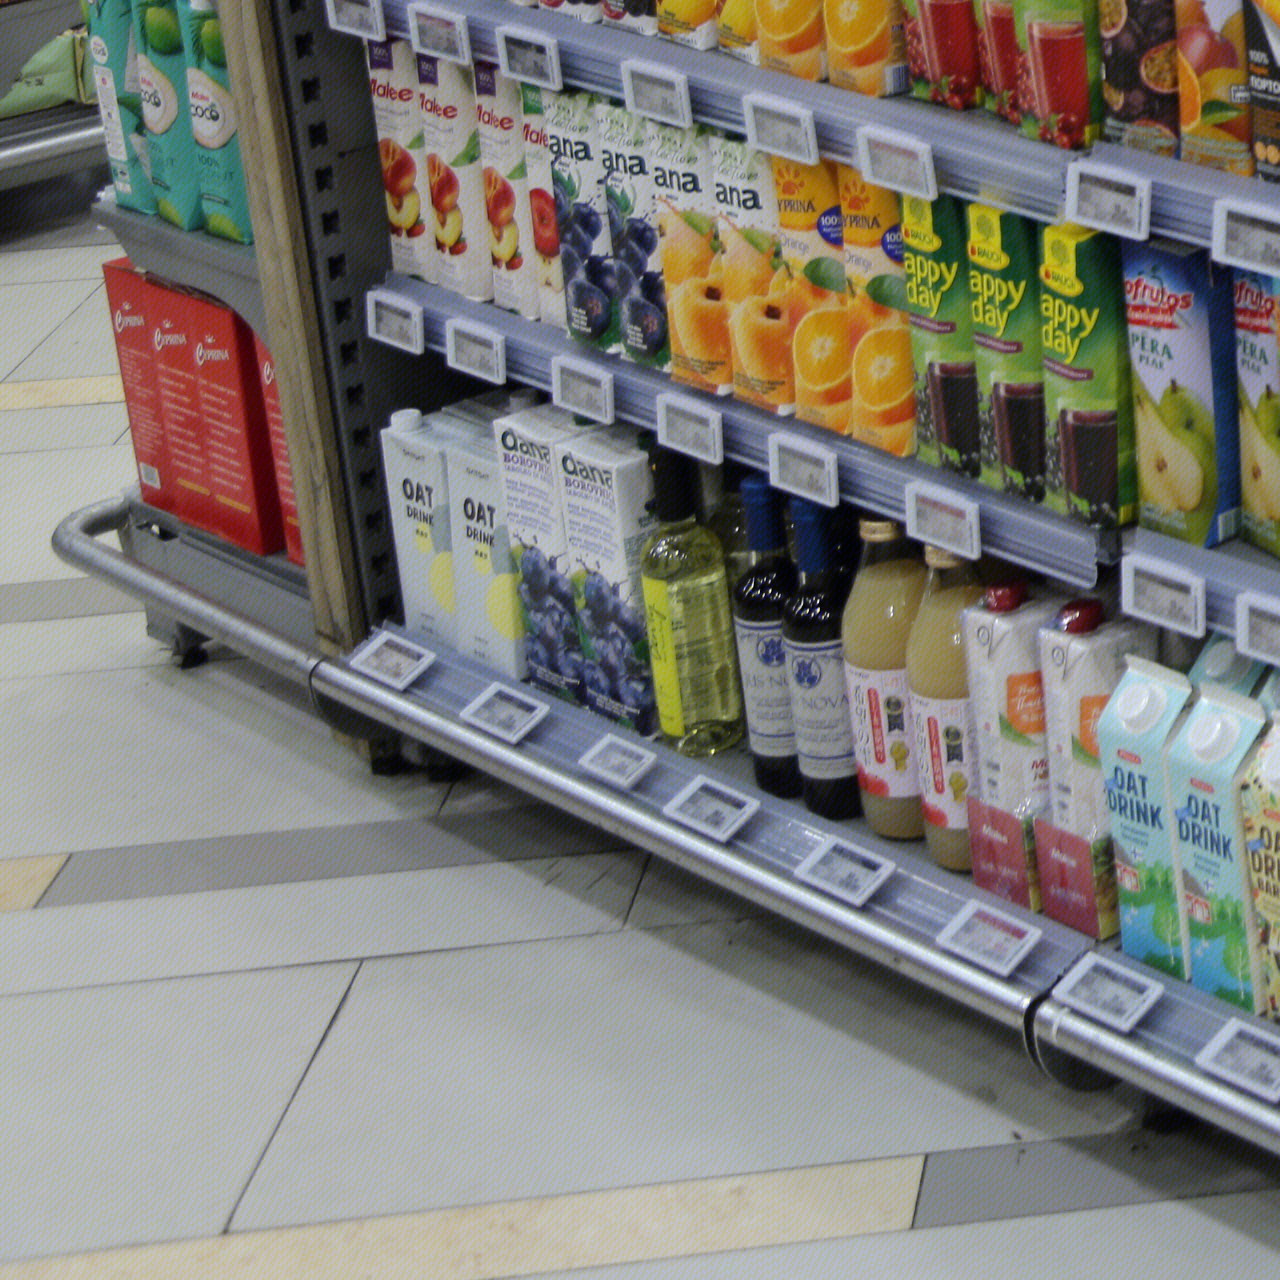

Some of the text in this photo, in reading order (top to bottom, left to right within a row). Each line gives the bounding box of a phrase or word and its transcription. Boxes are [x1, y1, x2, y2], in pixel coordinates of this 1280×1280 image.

[905, 279, 944, 318] day
[970, 298, 1011, 338] day
[1042, 323, 1083, 365] day
[501, 427, 550, 464] dana
[561, 451, 613, 490] dana
[401, 477, 434, 509] OAT
[406, 504, 435, 528] DRINK
[462, 495, 496, 529] OAT
[465, 524, 496, 548] DRINK
[1113, 764, 1149, 799] OAT
[1106, 790, 1165, 831] DRINK
[1186, 793, 1222, 829] OAT
[1178, 819, 1234, 863] DRINK
